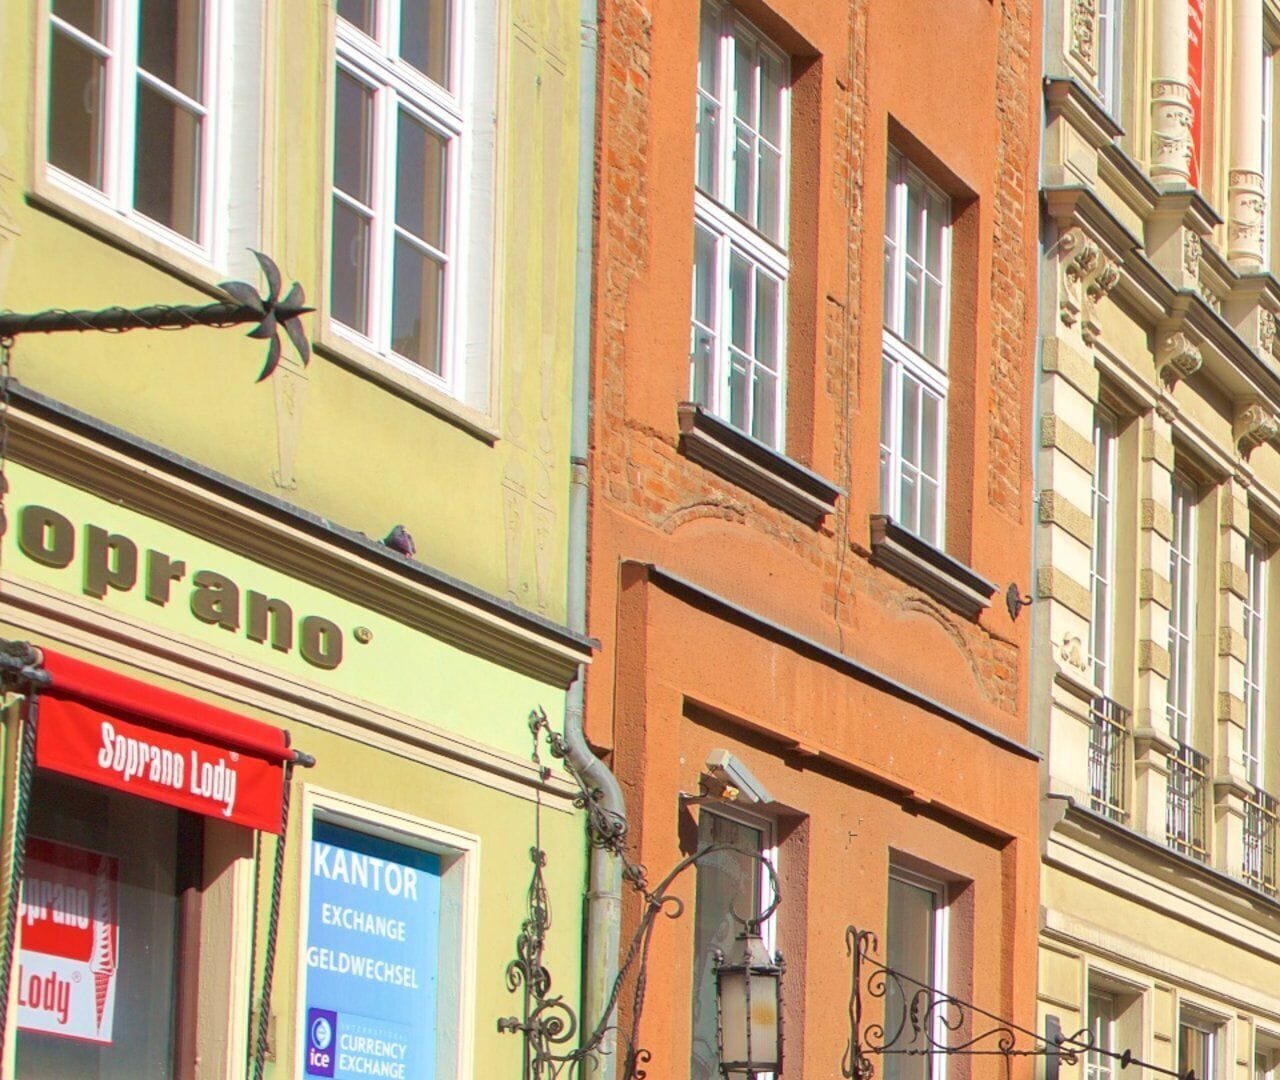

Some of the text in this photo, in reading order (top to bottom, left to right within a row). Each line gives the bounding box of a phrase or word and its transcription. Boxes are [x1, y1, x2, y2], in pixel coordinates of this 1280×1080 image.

[98, 721, 236, 816] Soprano Lody
[314, 841, 418, 901] KANTOR
[322, 902, 406, 942] EXCHANGE
[307, 946, 418, 989] GELDWECHSEL
[17, 963, 71, 1025] Lody
[309, 1048, 330, 1068] ice
[339, 1053, 406, 1080] EXCHANGE
[340, 1033, 407, 1060] CURRENCY
